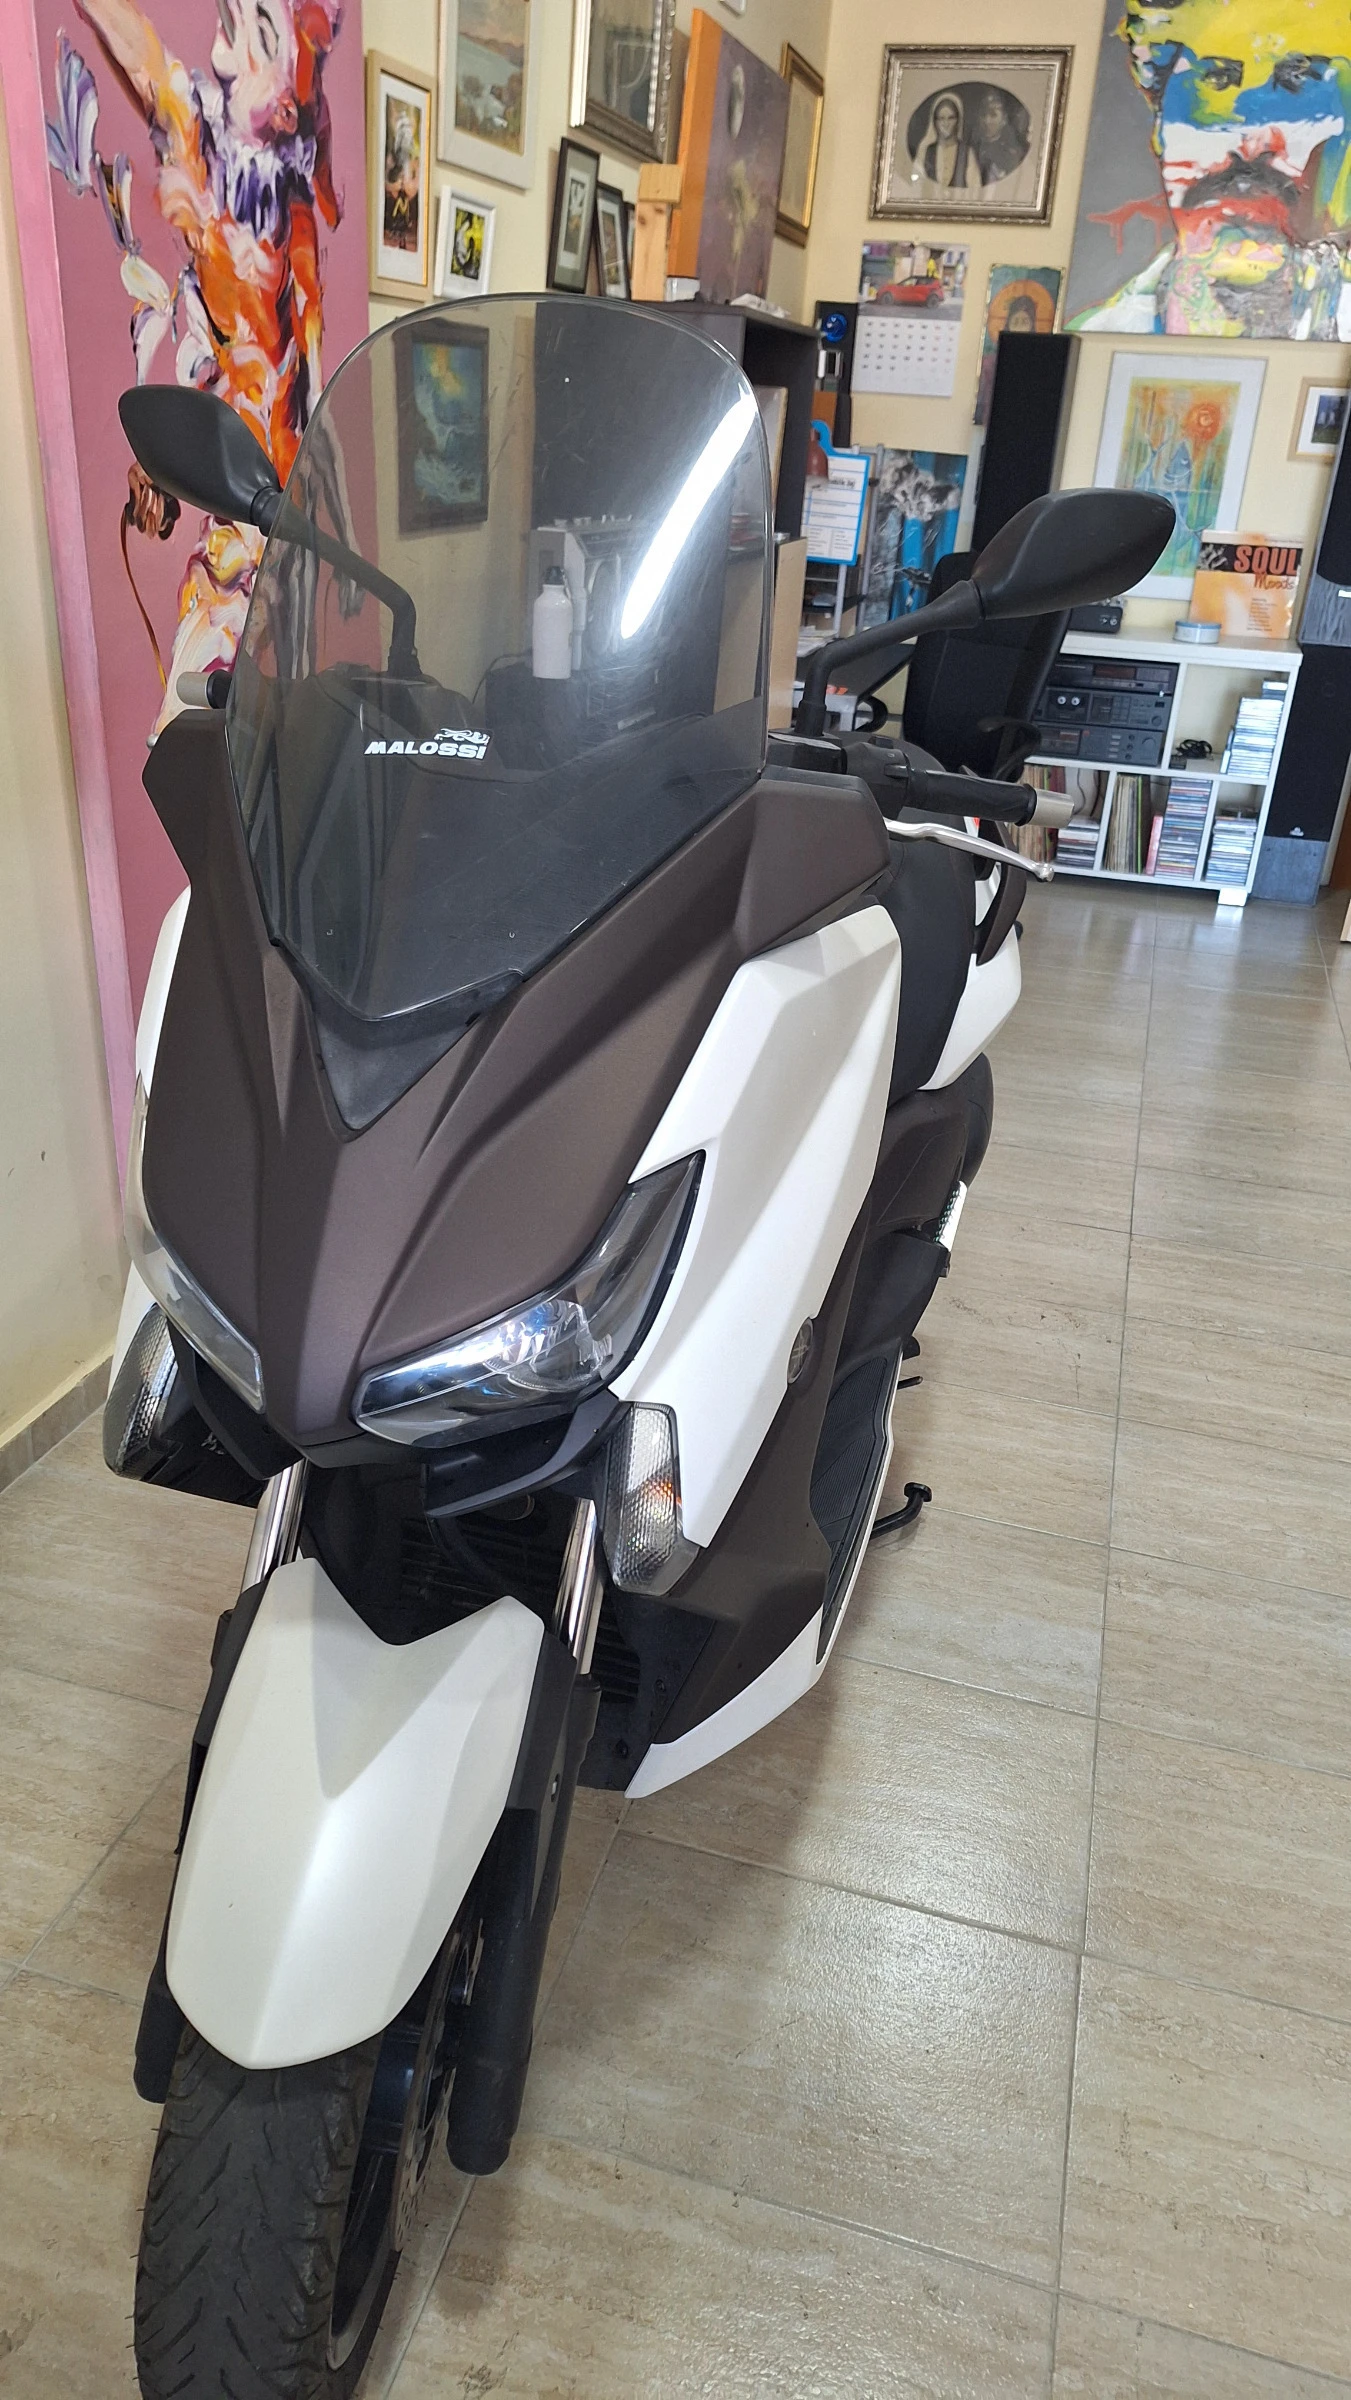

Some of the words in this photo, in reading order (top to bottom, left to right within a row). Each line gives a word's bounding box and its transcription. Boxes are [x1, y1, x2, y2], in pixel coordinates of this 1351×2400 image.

[1233, 545, 1297, 575] SOUL
[1254, 572, 1295, 590] Moods
[364, 741, 487, 760] MALOSSI
